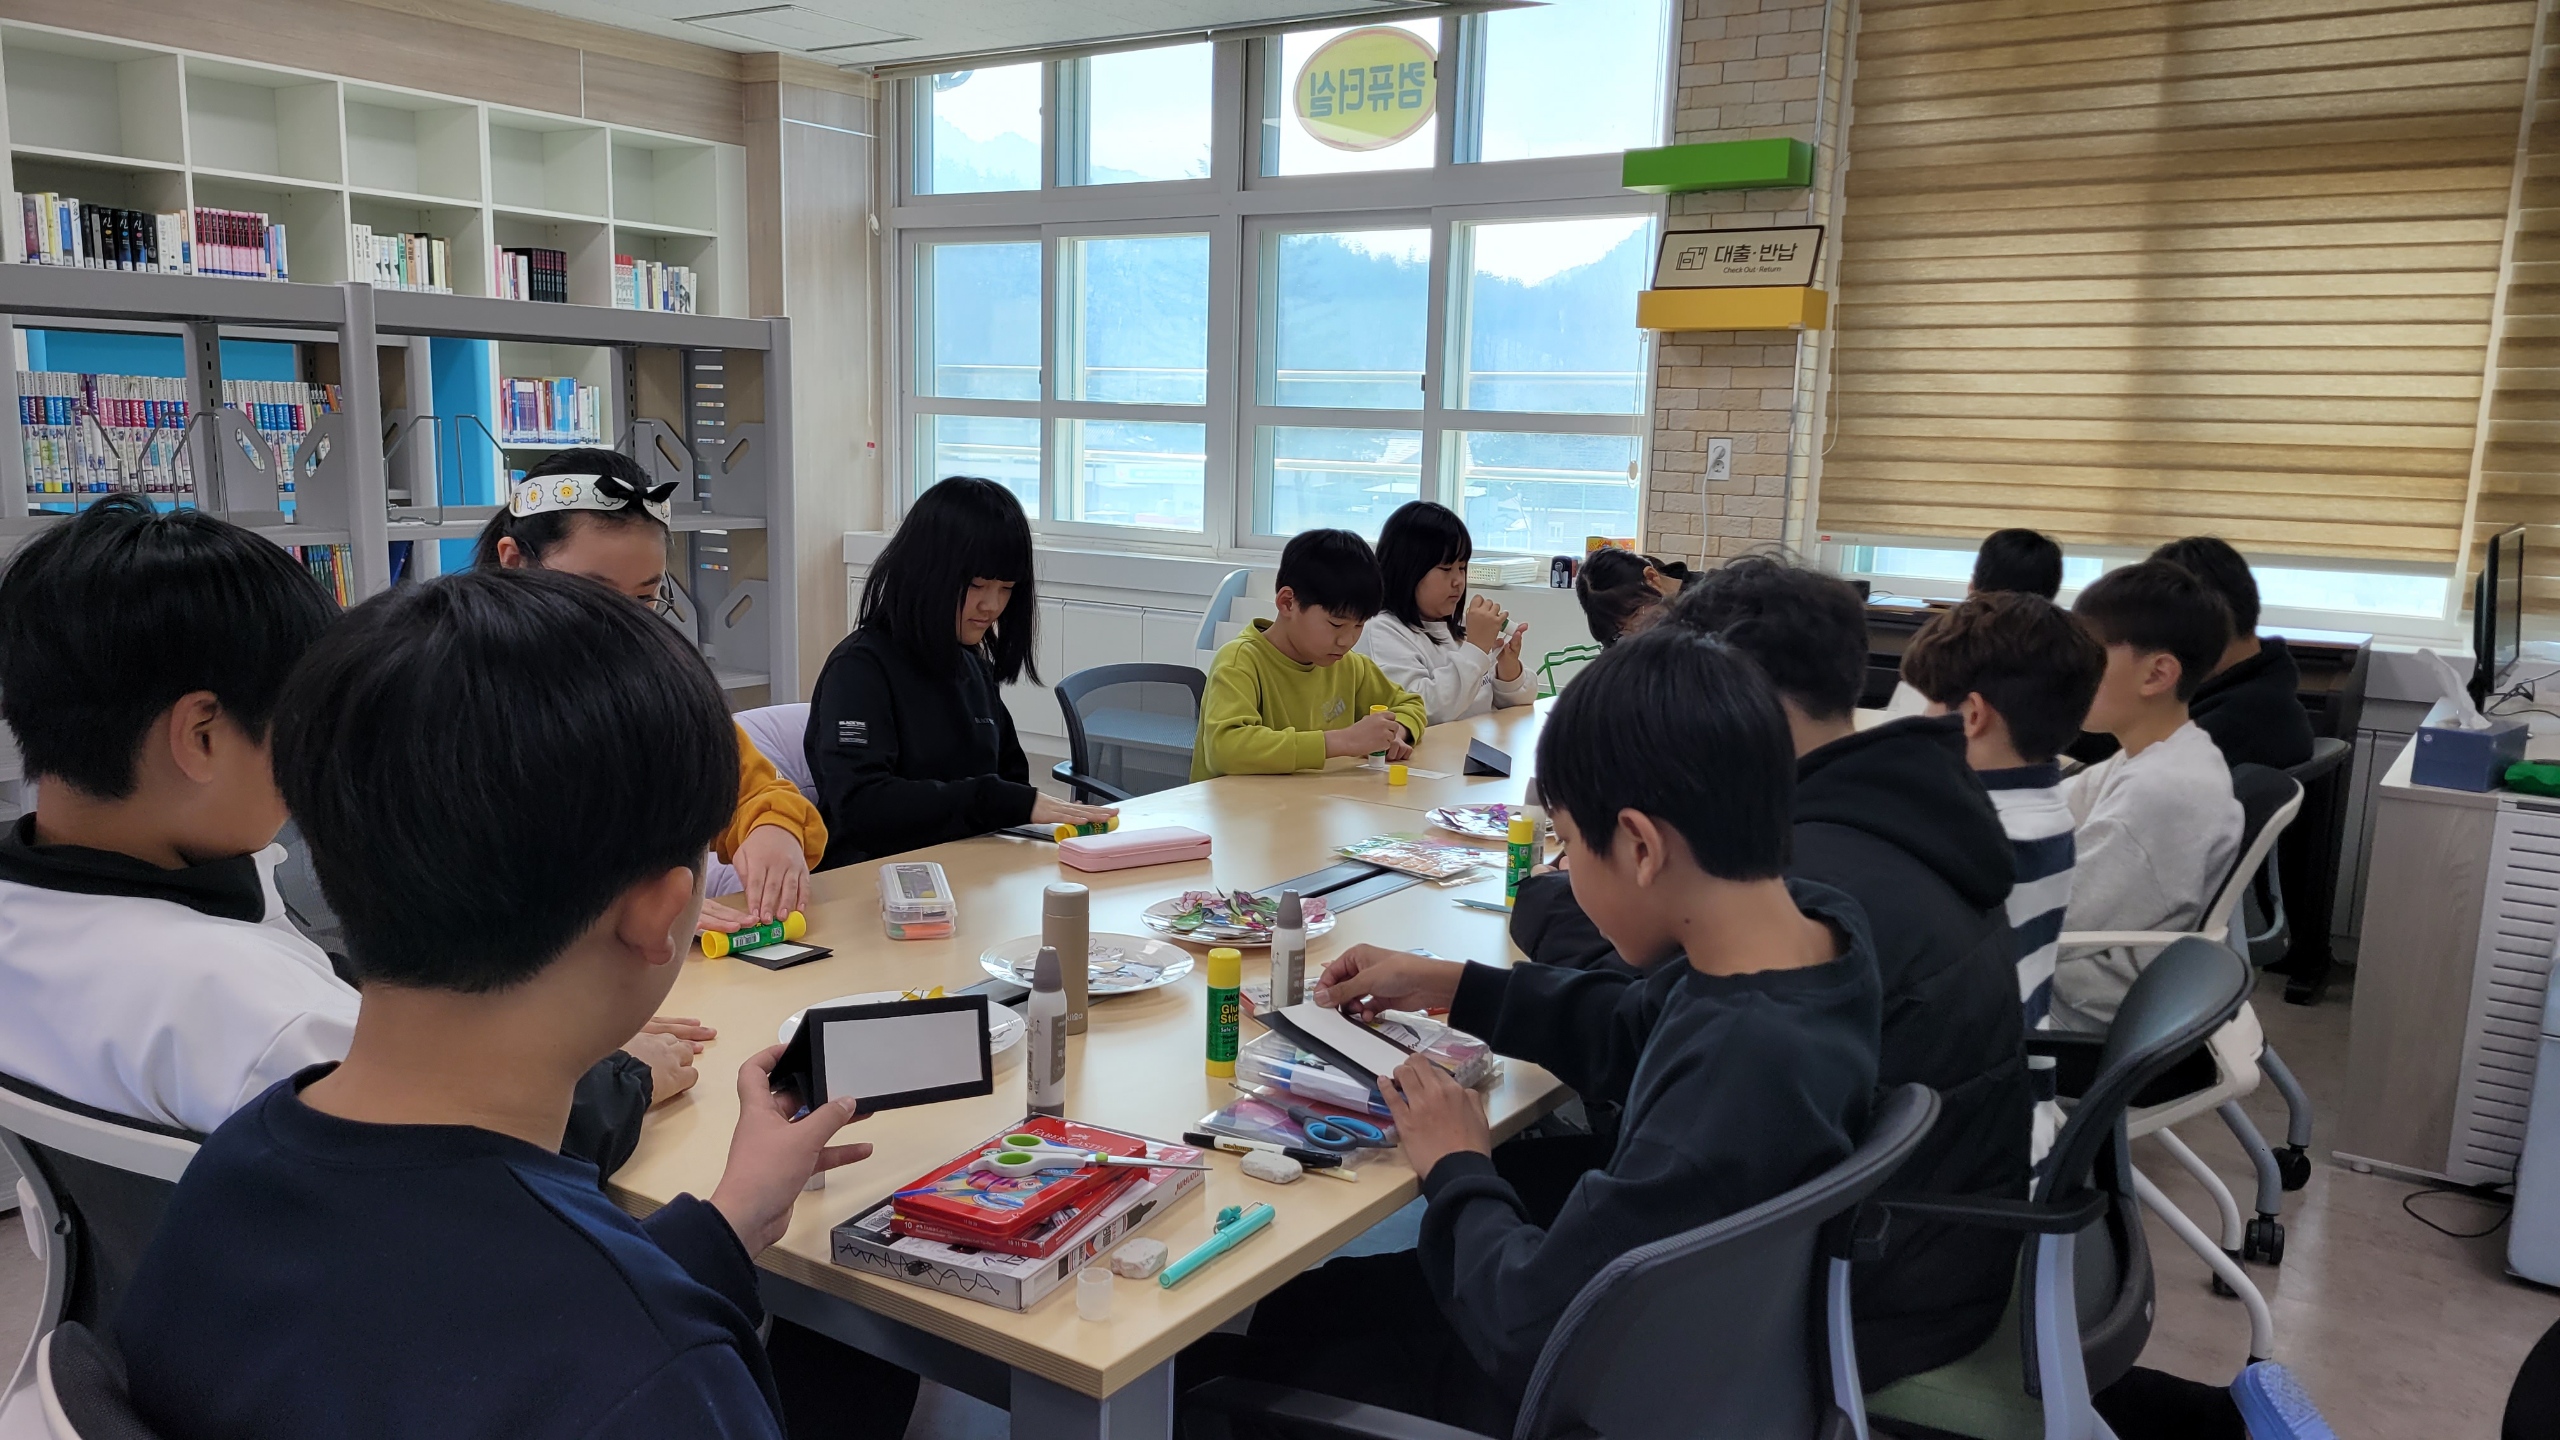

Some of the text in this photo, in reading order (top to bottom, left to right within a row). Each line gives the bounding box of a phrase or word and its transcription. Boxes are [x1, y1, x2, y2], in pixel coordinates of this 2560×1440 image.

[1714, 243, 1798, 263] 대출·반납
[1221, 1004, 1238, 1014] Glu
[1220, 1014, 1238, 1024] Stic
